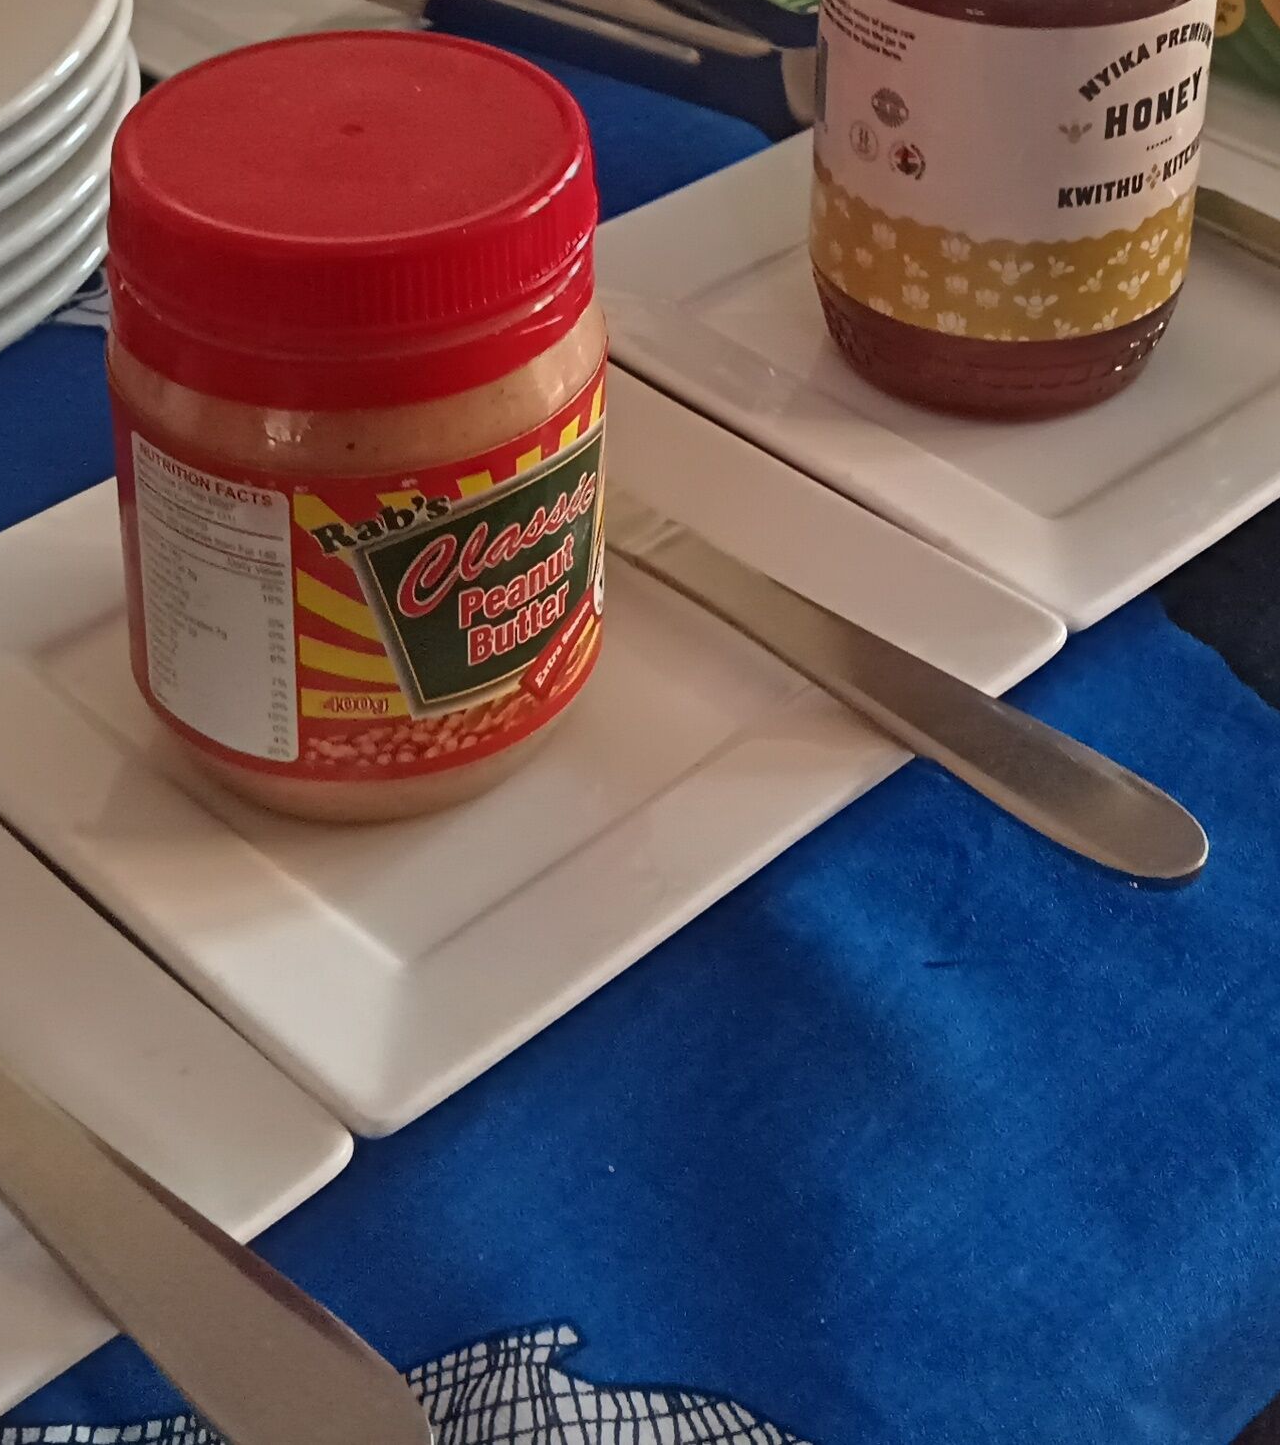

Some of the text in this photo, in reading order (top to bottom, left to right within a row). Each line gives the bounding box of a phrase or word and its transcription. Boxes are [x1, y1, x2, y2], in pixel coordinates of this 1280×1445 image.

[1078, 42, 1151, 103] NYIKA
[1103, 65, 1203, 141] HONEY
[1057, 171, 1145, 210] KWITHU
[138, 441, 211, 493] NUTRITION
[214, 482, 274, 508] FACTS
[311, 494, 452, 559] Rab's
[396, 470, 598, 619] Classic
[458, 532, 575, 630] Peanut
[467, 579, 570, 667] Butter
